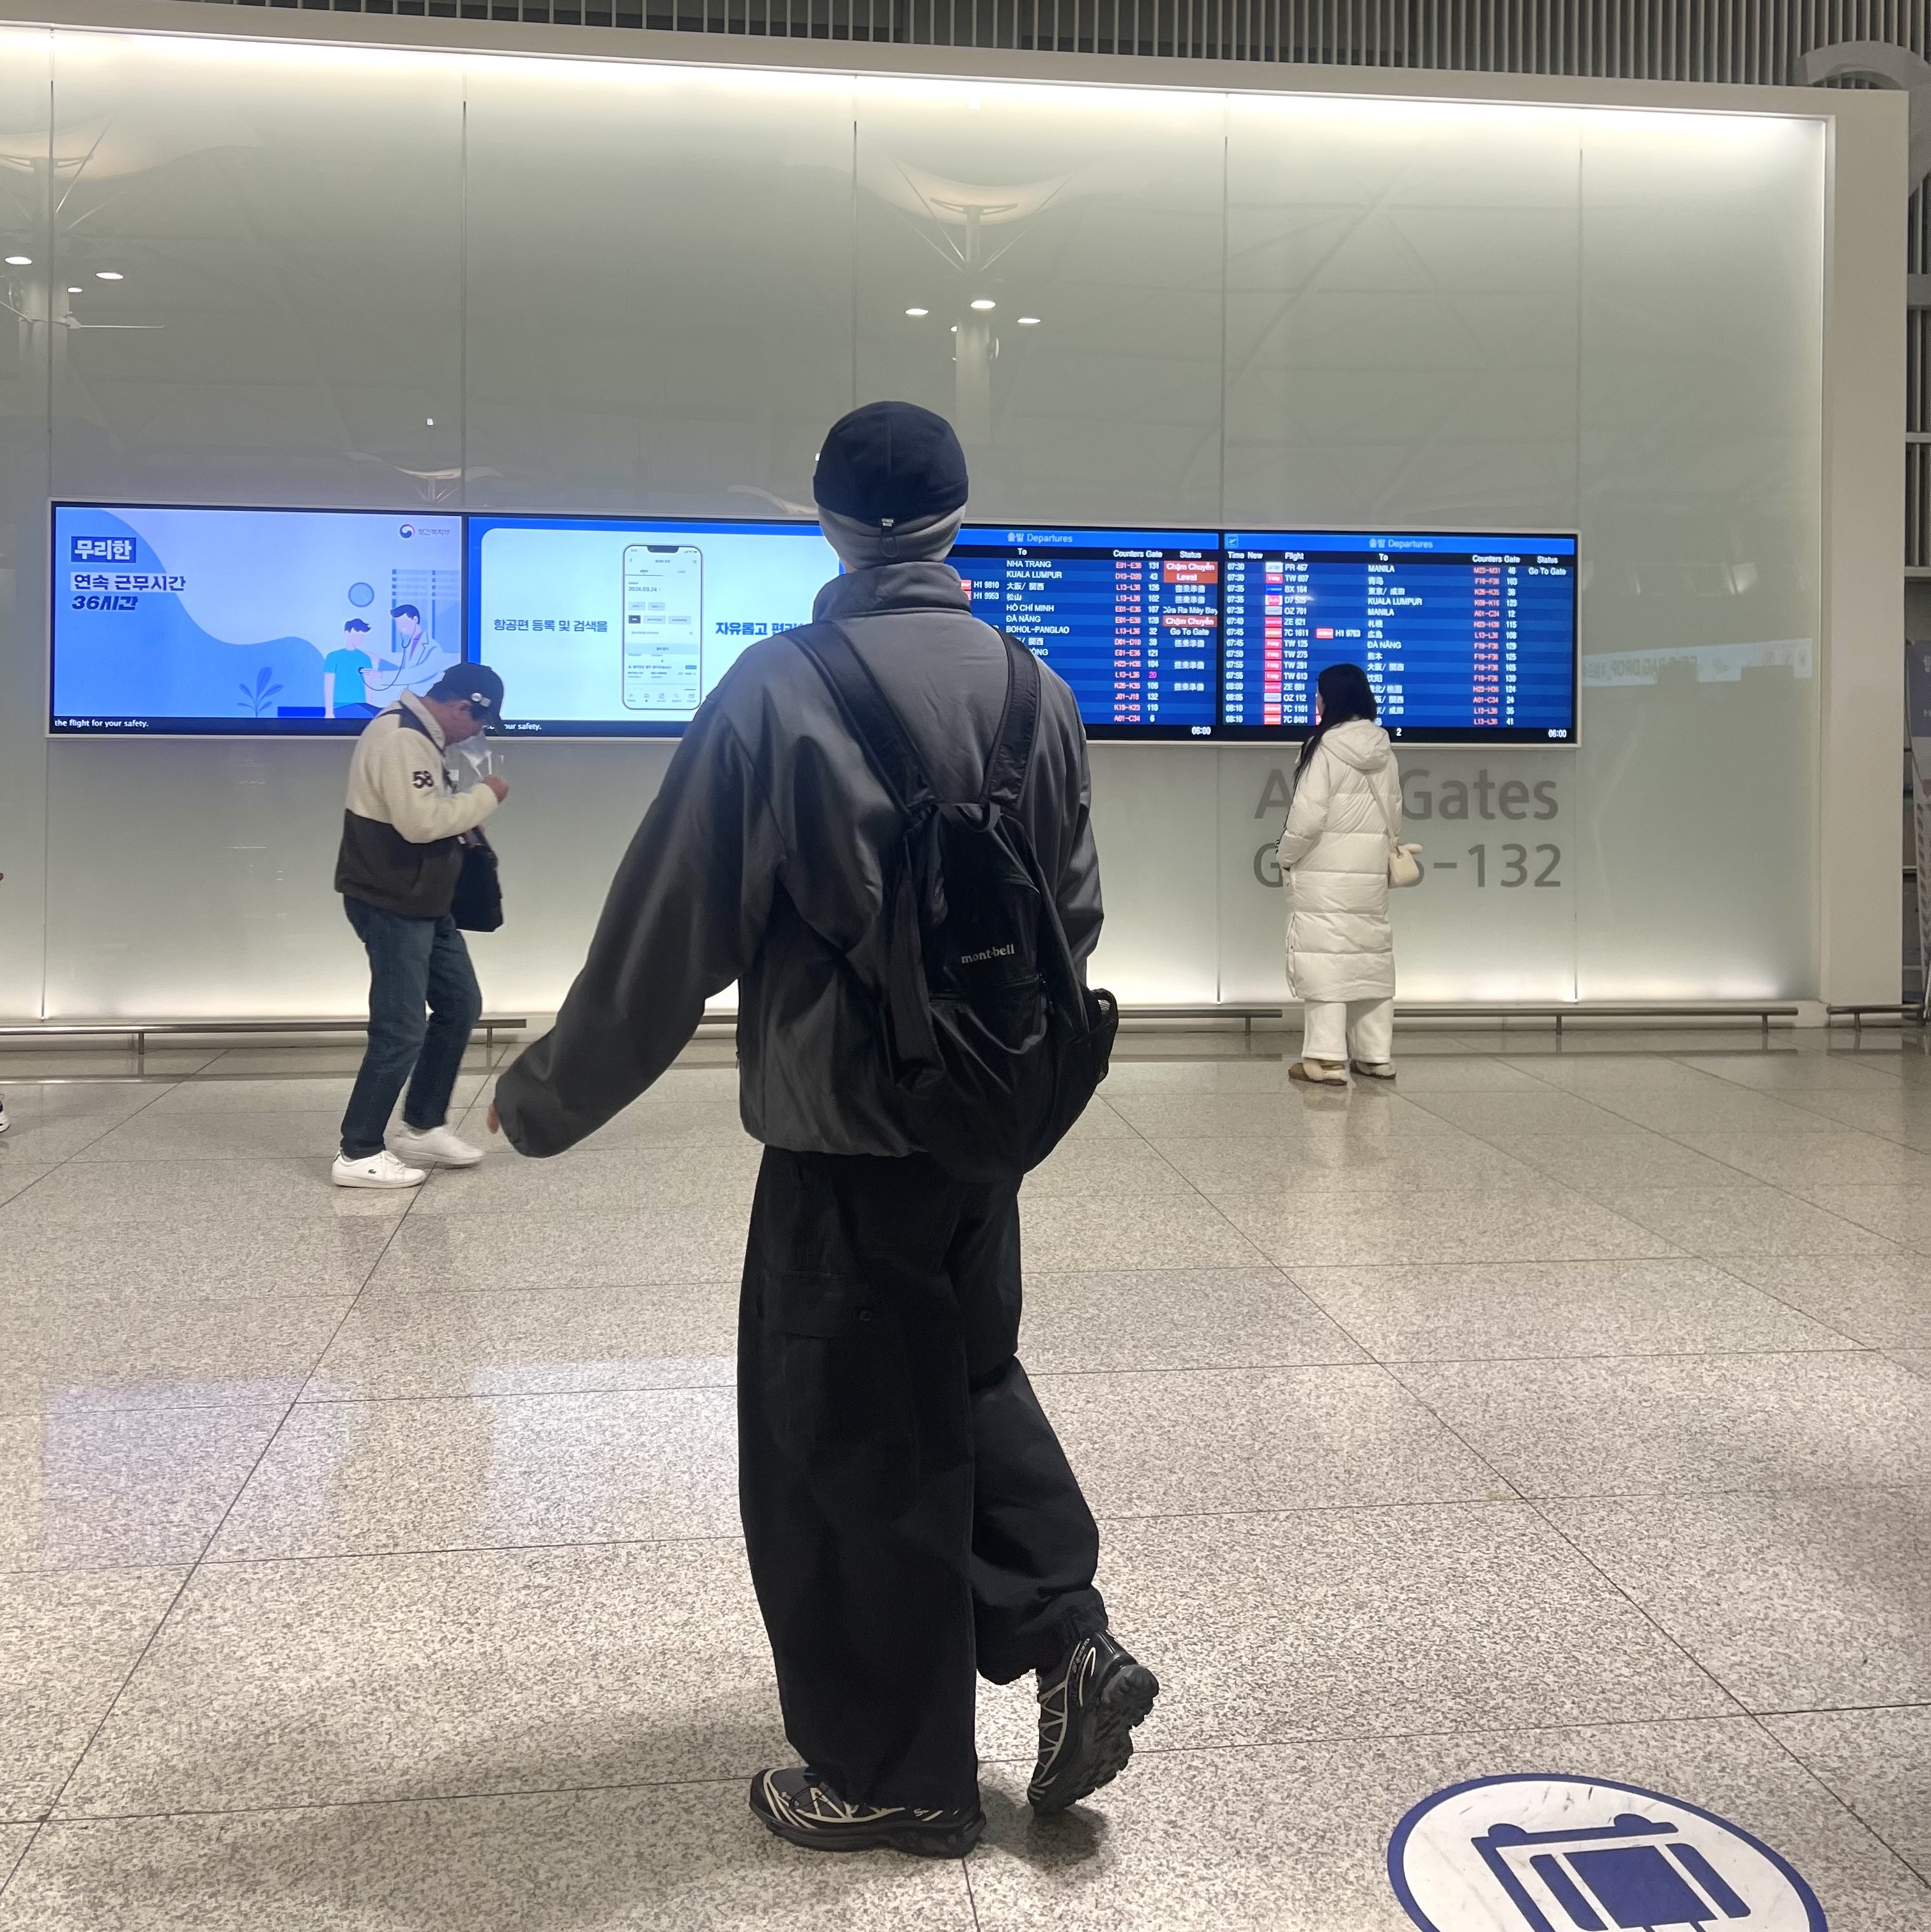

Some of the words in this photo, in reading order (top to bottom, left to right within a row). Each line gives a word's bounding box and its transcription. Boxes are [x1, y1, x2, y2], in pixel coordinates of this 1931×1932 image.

[1007, 532, 1024, 542] 출발
[1027, 533, 1073, 544] Departures
[1388, 539, 1433, 549] Departures
[74, 540, 132, 560] 무리한
[1285, 552, 1304, 561] Flight
[1472, 554, 1502, 563] Counters
[1504, 555, 1520, 563] Gate
[1537, 556, 1558, 564] Status
[1368, 565, 1395, 573] MANILA
[1550, 567, 1566, 575] Gate
[74, 574, 109, 590] 연속
[114, 575, 186, 591] 근무시간
[72, 595, 139, 611] 36시간
[1019, 604, 1033, 612] CHÍ
[494, 619, 529, 631] 항공편
[532, 620, 555, 632] 등록
[559, 620, 570, 632] 및
[574, 621, 607, 632] 검색을
[715, 621, 768, 635] 자유롭고
[1226, 682, 1244, 690] 08:00
[69, 719, 89, 728] flight
[124, 720, 149, 728] safety.
[1283, 715, 1292, 724] 7C
[517, 722, 542, 731] safety.
[1191, 726, 1211, 734] 06:00
[1396, 727, 1402, 736] 2
[1548, 729, 1567, 738] 06:00
[1400, 768, 1559, 821] Gates
